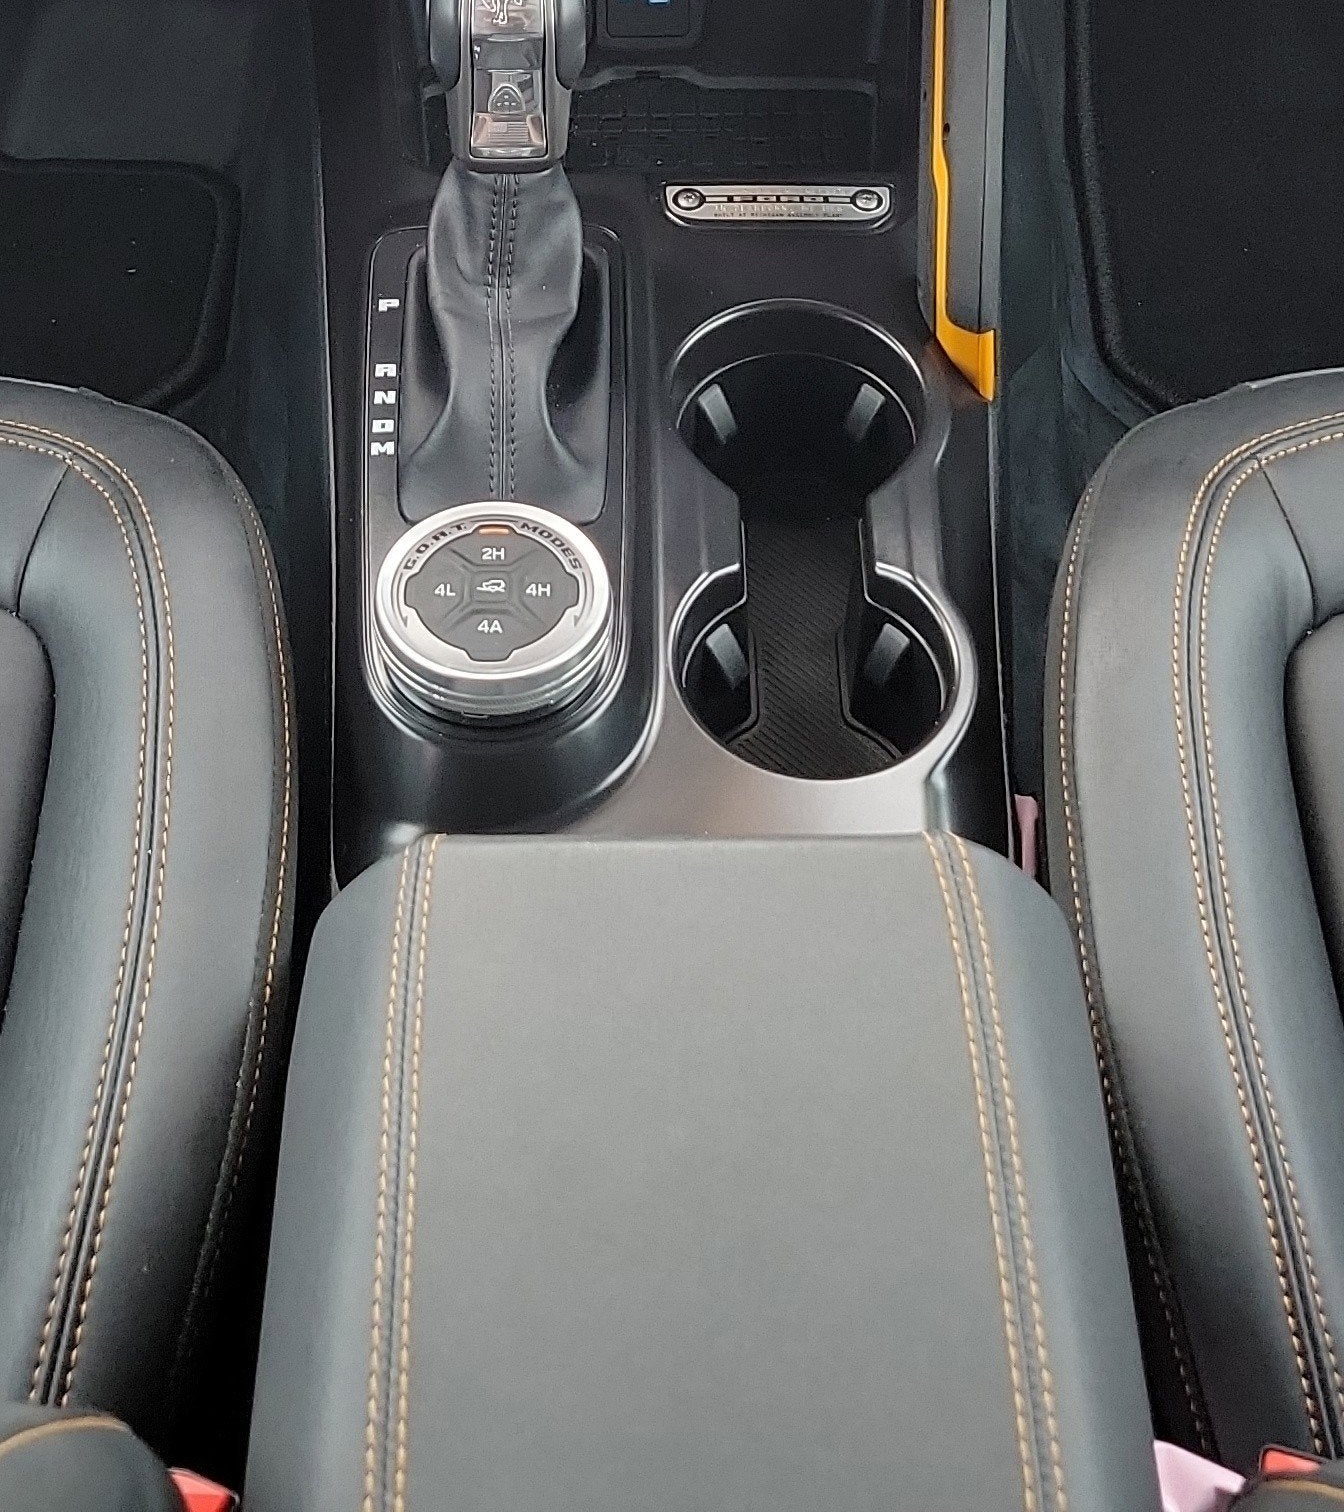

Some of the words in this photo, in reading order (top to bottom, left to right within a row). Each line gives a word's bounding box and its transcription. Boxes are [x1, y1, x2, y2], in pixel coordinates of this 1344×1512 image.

[378, 298, 400, 312] P
[373, 390, 396, 405] N
[372, 418, 396, 434] D
[370, 440, 396, 456] M
[480, 547, 506, 561] 2H
[519, 522, 582, 571] MODES
[434, 583, 456, 597] 4L
[525, 583, 552, 597] 4H
[476, 619, 503, 634] 4A
